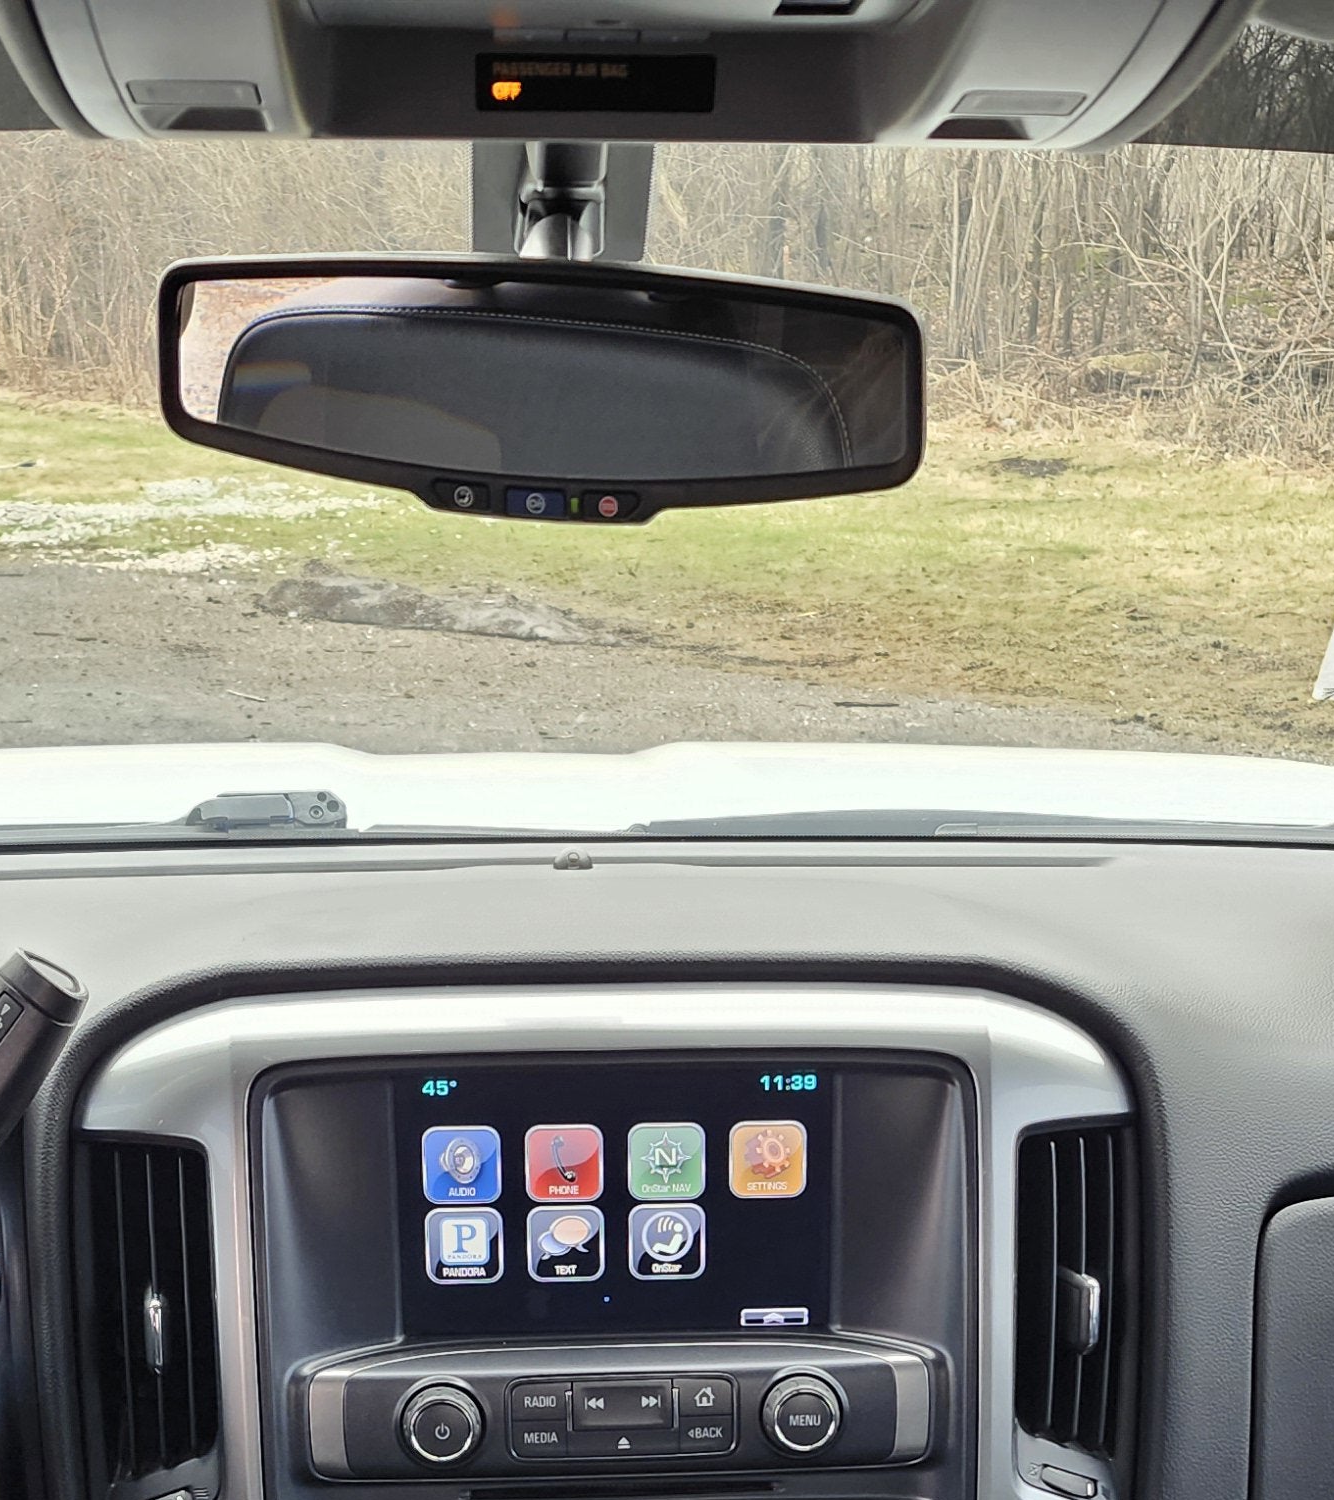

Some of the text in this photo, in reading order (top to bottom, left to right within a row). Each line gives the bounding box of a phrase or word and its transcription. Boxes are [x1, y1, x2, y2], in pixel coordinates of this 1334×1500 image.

[421, 1079, 458, 1097] 45°
[448, 1186, 476, 1197] AUDIO
[548, 1185, 580, 1196] PHONE
[641, 1183, 692, 1193] OnStar NAV
[746, 1181, 788, 1191] SETTINGS
[451, 1224, 477, 1254] P
[442, 1267, 486, 1277] PANDORA
[554, 1265, 578, 1276] TEXT
[651, 1263, 683, 1273] OnStar
[524, 1395, 557, 1408] RADIO
[788, 1414, 822, 1427] MENU
[524, 1432, 558, 1444] MEDIA
[695, 1426, 723, 1440] BACK
